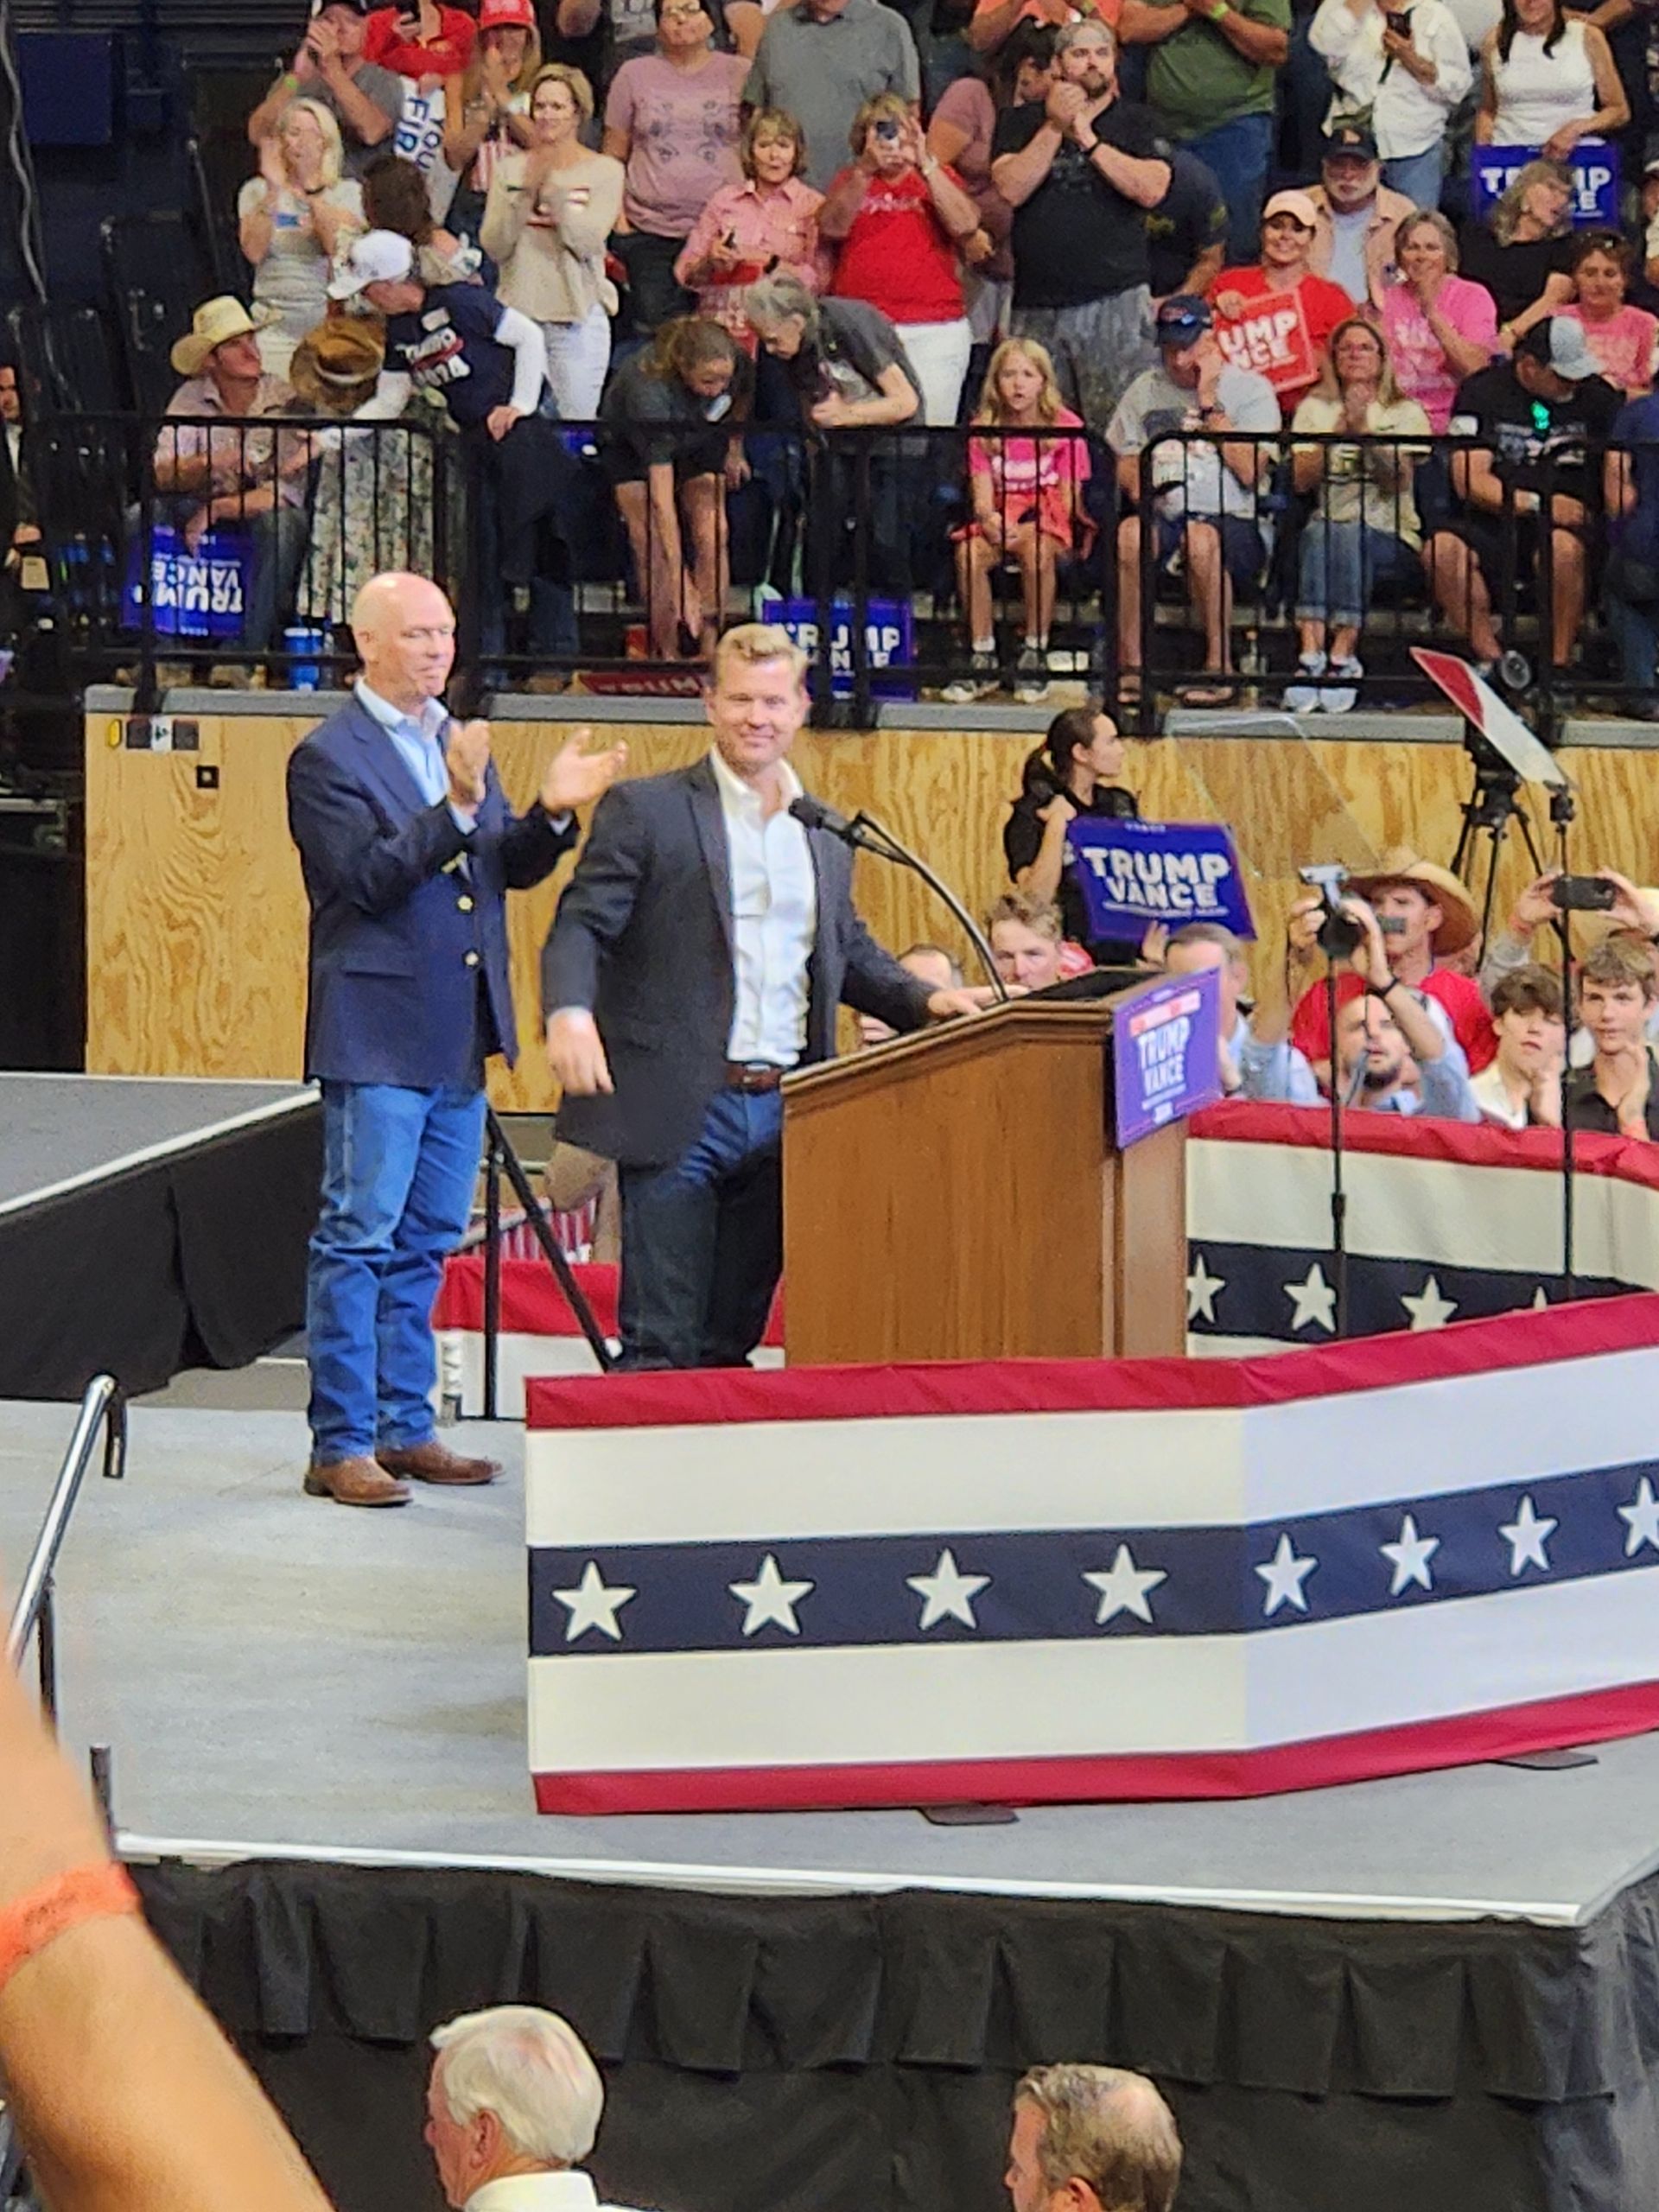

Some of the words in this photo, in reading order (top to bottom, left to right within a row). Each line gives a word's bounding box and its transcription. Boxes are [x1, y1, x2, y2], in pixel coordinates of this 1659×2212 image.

[1217, 312, 1297, 356] UMP
[1082, 846, 1230, 885] TRUMP
[1106, 877, 1218, 908] VANCE
[1138, 1015, 1190, 1070] TRUMP
[1143, 1052, 1185, 1097] VANCE
